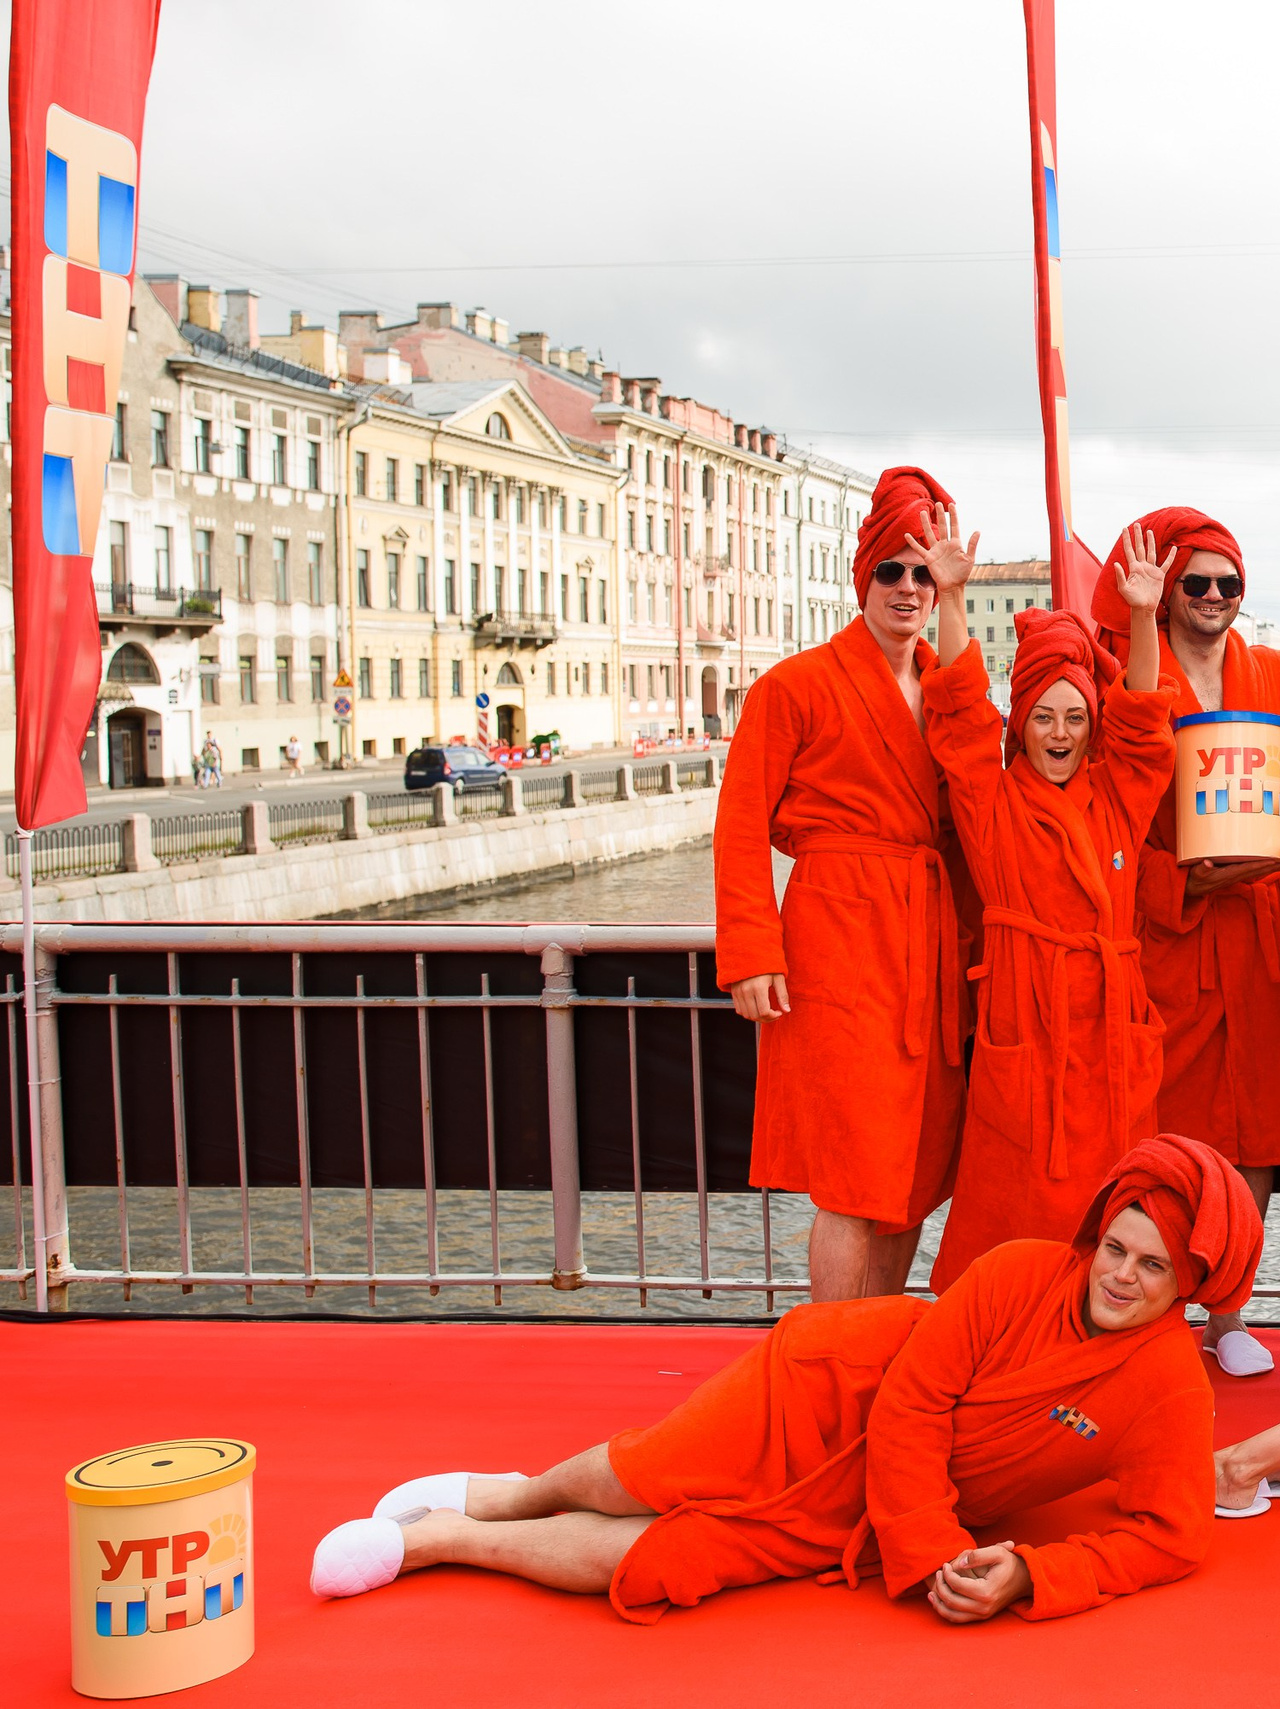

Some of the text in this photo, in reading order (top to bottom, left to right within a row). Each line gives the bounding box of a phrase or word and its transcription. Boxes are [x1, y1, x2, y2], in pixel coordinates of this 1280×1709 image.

[42, 103, 137, 556] ТНТ
[1049, 1404, 1100, 1440] ТНТ
[96, 1558, 244, 1637] ТНТ
